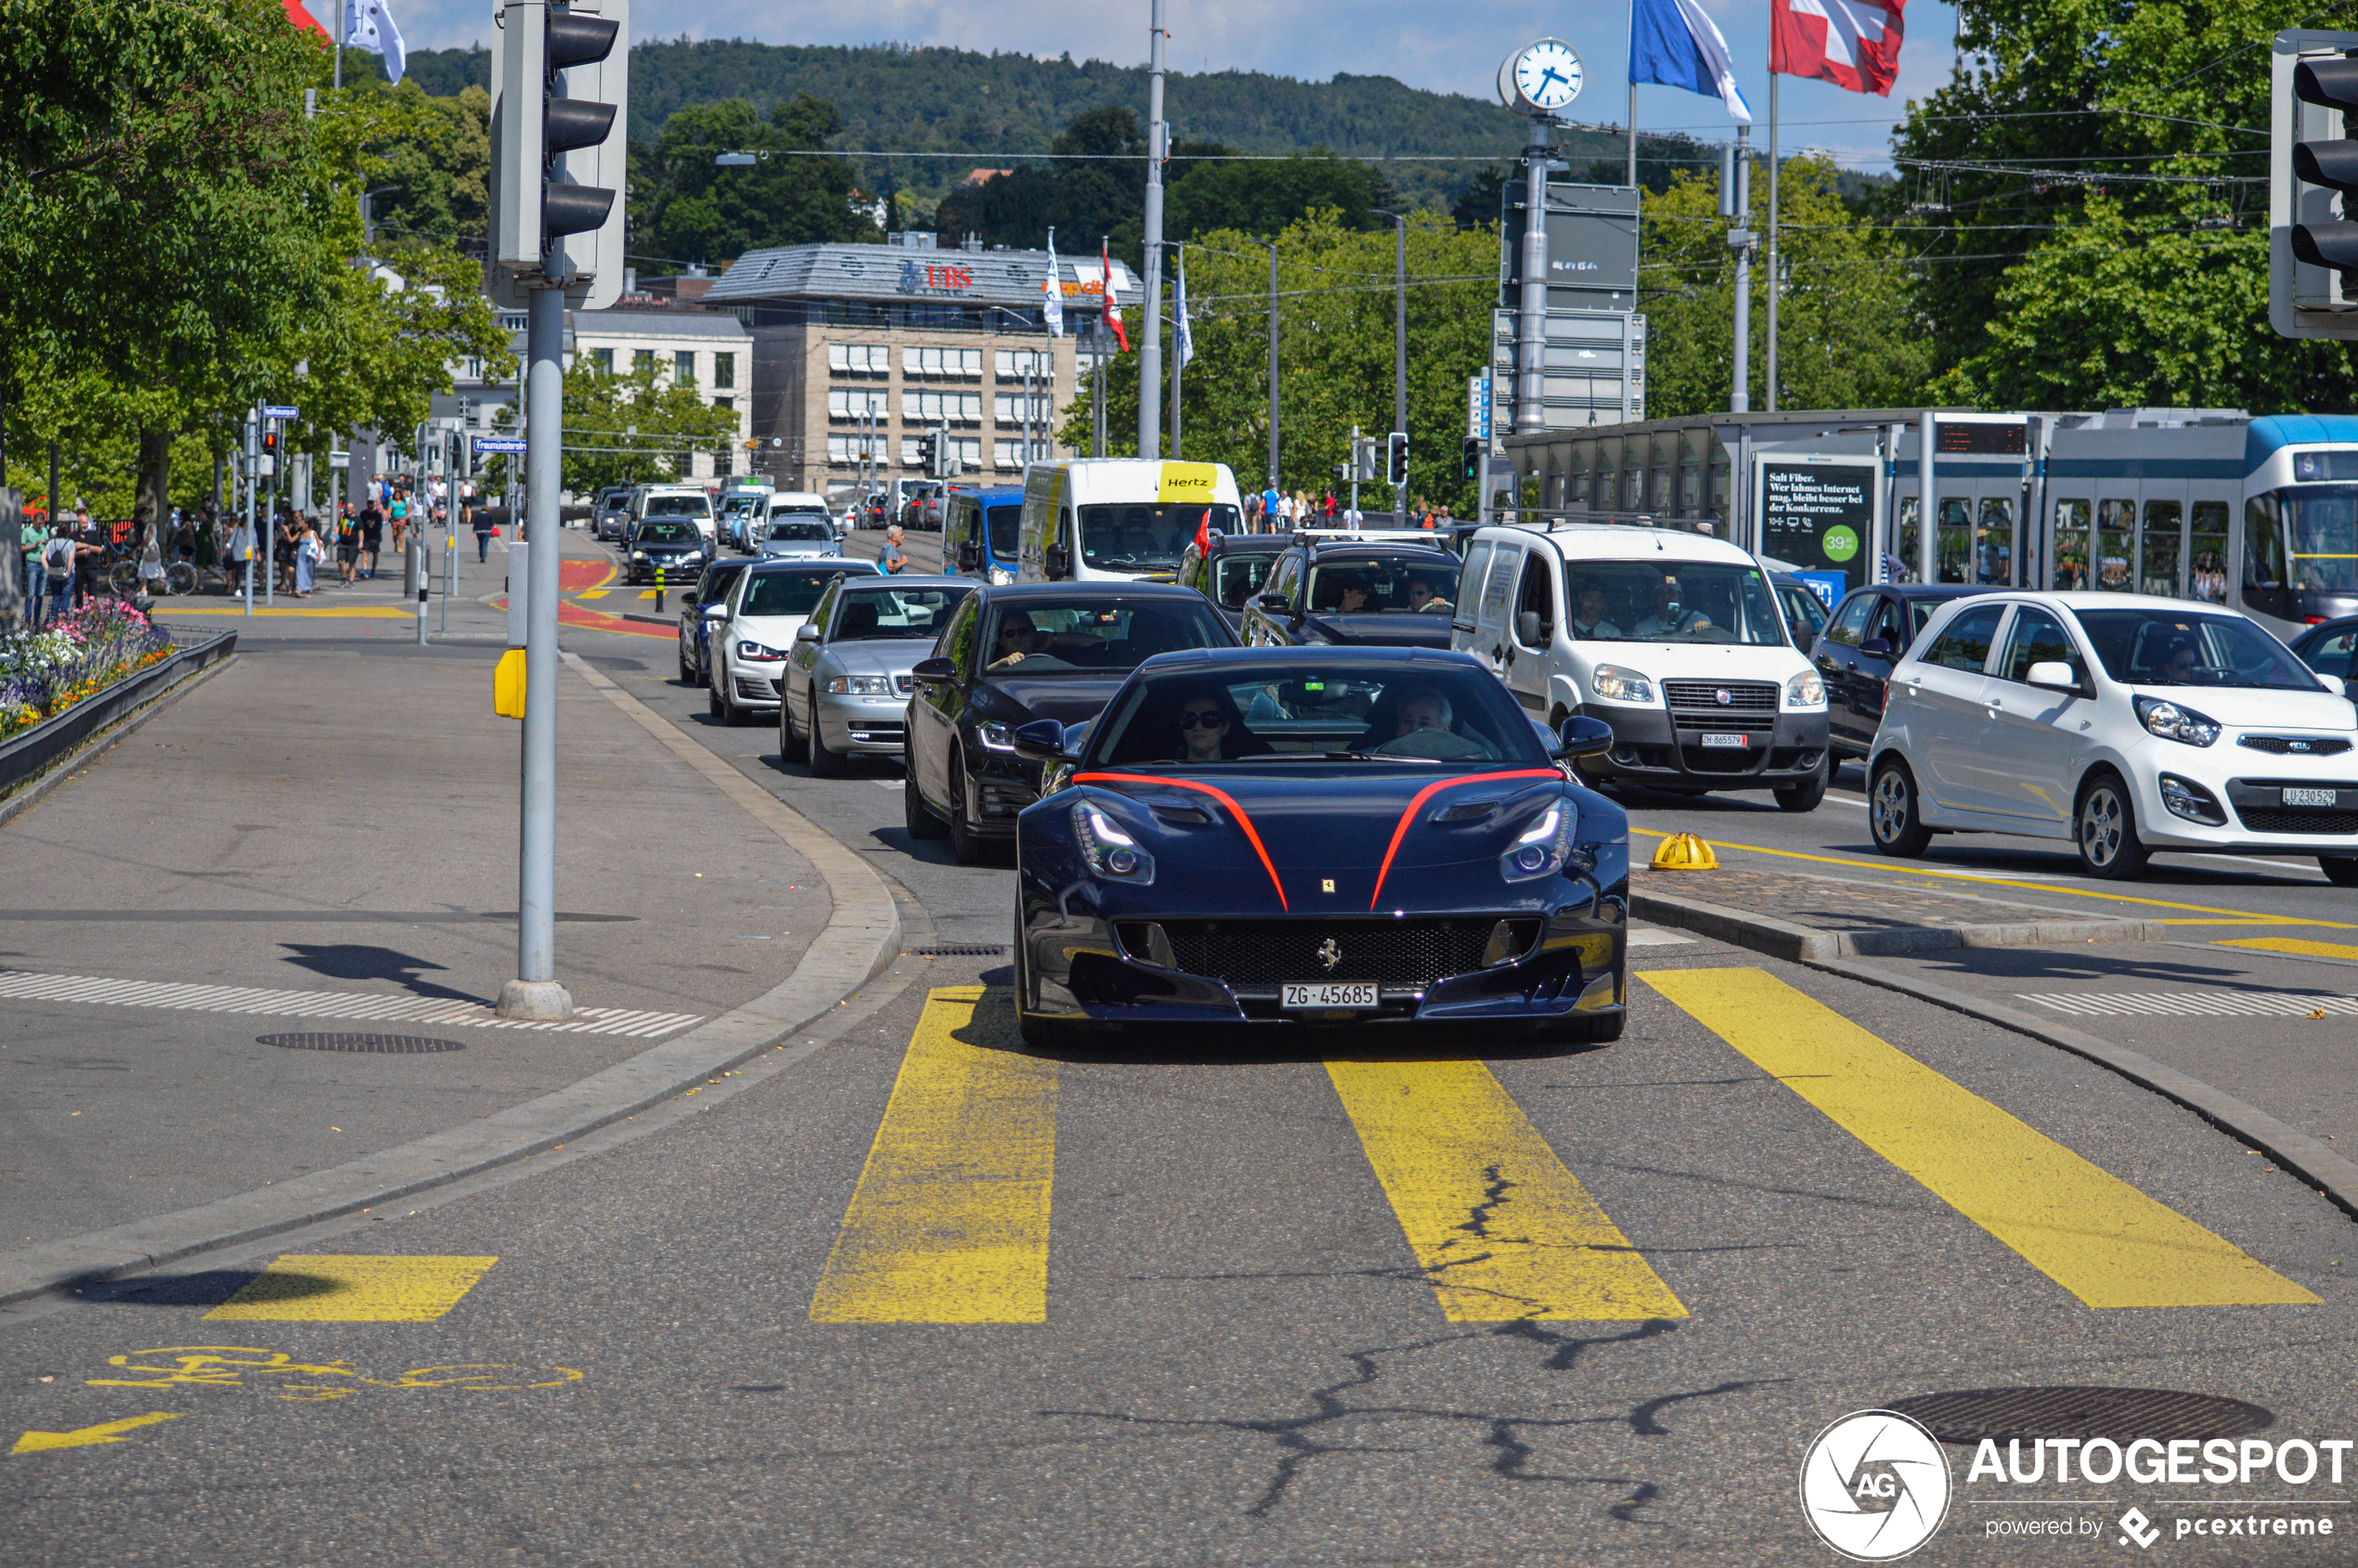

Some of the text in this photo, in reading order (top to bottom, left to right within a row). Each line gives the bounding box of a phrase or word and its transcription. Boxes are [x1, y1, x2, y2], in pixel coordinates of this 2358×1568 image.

[927, 266, 971, 289] UBS
[1082, 279, 1105, 295] cit
[2303, 456, 2314, 473] 9
[1168, 478, 1208, 486] Hertz
[1768, 473, 1815, 483] Salt Fiber.
[1769, 483, 1860, 494] Wer lahmes Internet
[1793, 493, 1818, 502] bleibt
[1819, 493, 1847, 503] besser
[1848, 494, 1863, 504] bei
[1768, 502, 1844, 513] der Konkurrenz.
[1826, 536, 1845, 550] 39
[2293, 742, 2308, 750] KIA
